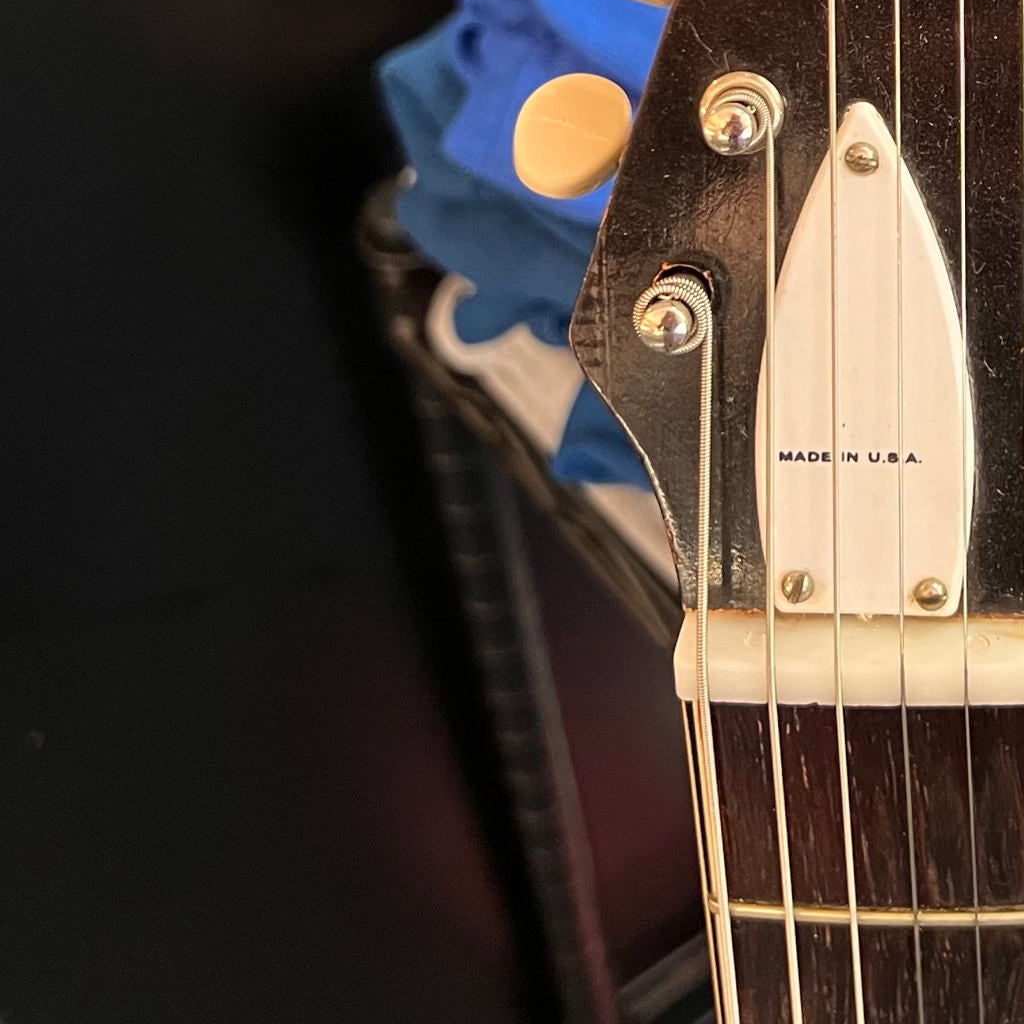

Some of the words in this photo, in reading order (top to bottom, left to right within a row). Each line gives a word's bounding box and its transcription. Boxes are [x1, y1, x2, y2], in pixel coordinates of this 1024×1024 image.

[779, 451, 832, 463] MADE
[841, 451, 859, 463] IN
[868, 451, 923, 464] U.SA.
